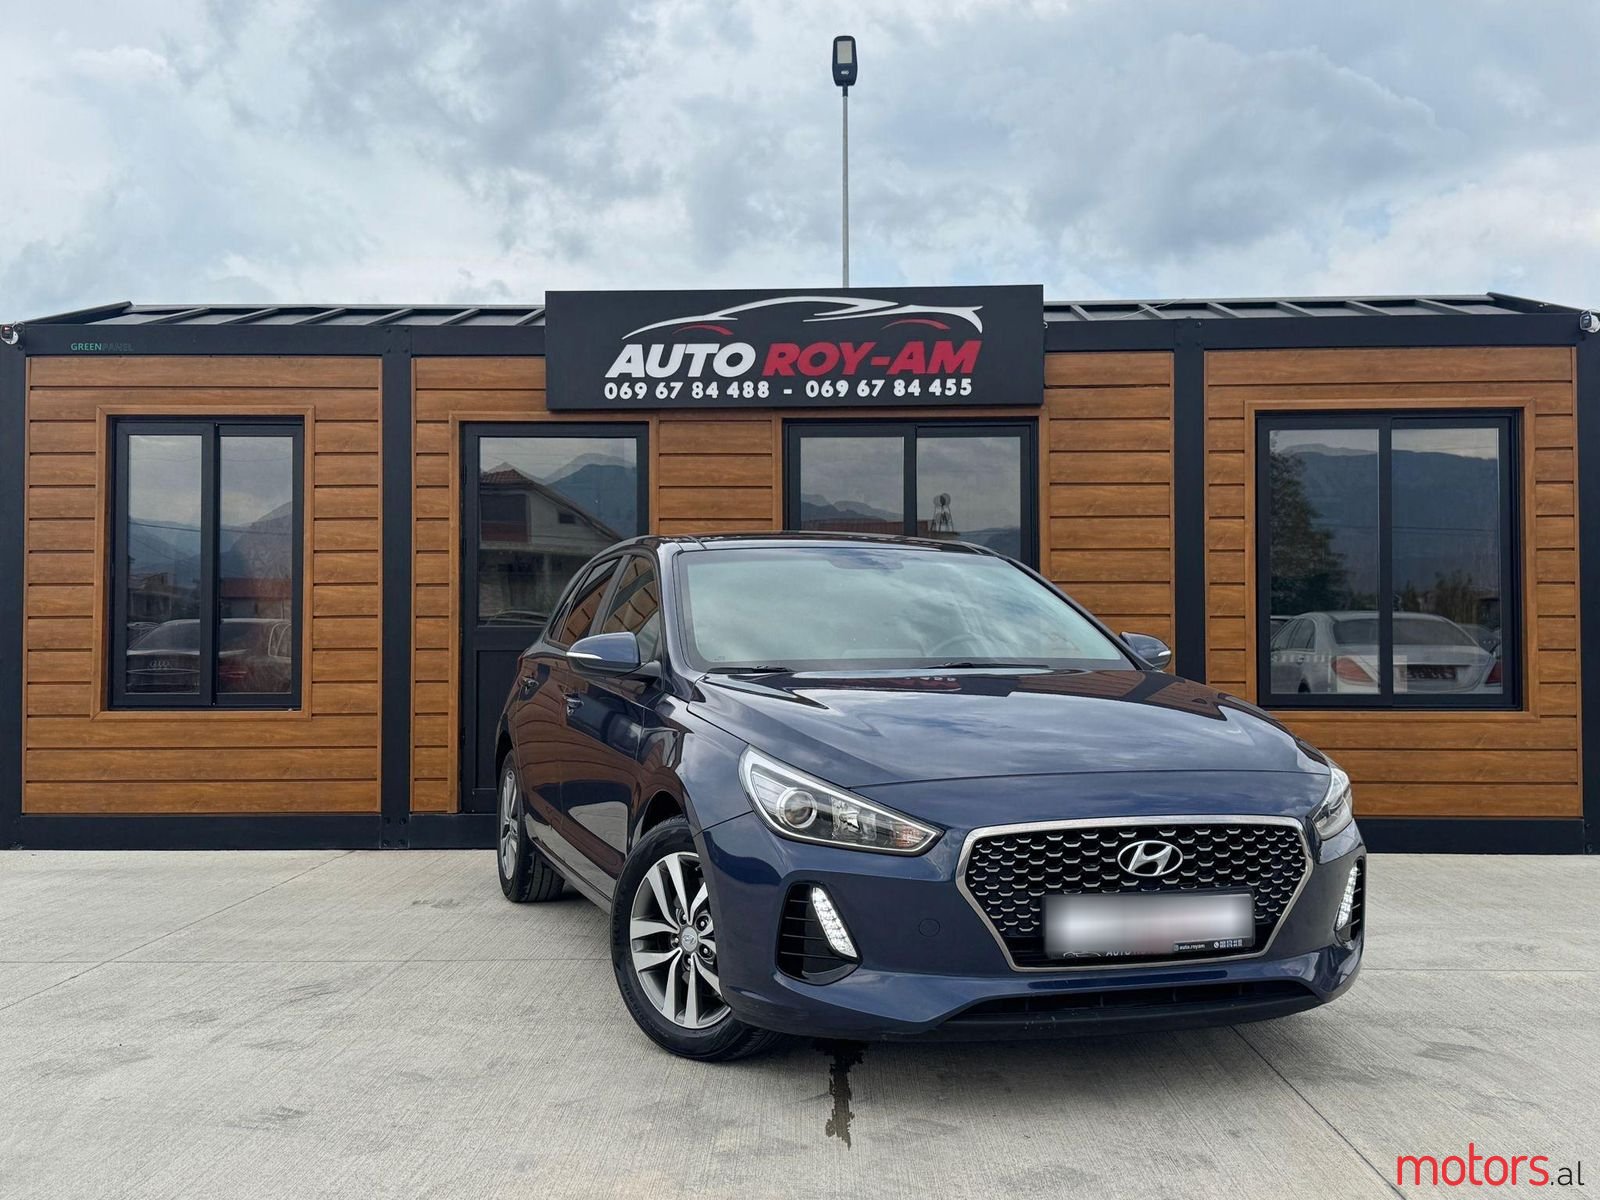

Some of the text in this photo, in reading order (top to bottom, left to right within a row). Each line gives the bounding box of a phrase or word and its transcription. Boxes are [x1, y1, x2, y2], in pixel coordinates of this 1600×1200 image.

[604, 341, 982, 378] AUTO ROY-AM
[604, 382, 648, 400] 069
[655, 381, 684, 399] 67
[691, 381, 719, 399] 84
[726, 380, 770, 399] 488
[805, 379, 849, 398] 069
[856, 379, 886, 398] 67
[893, 378, 921, 397] 84
[928, 378, 972, 396] 455
